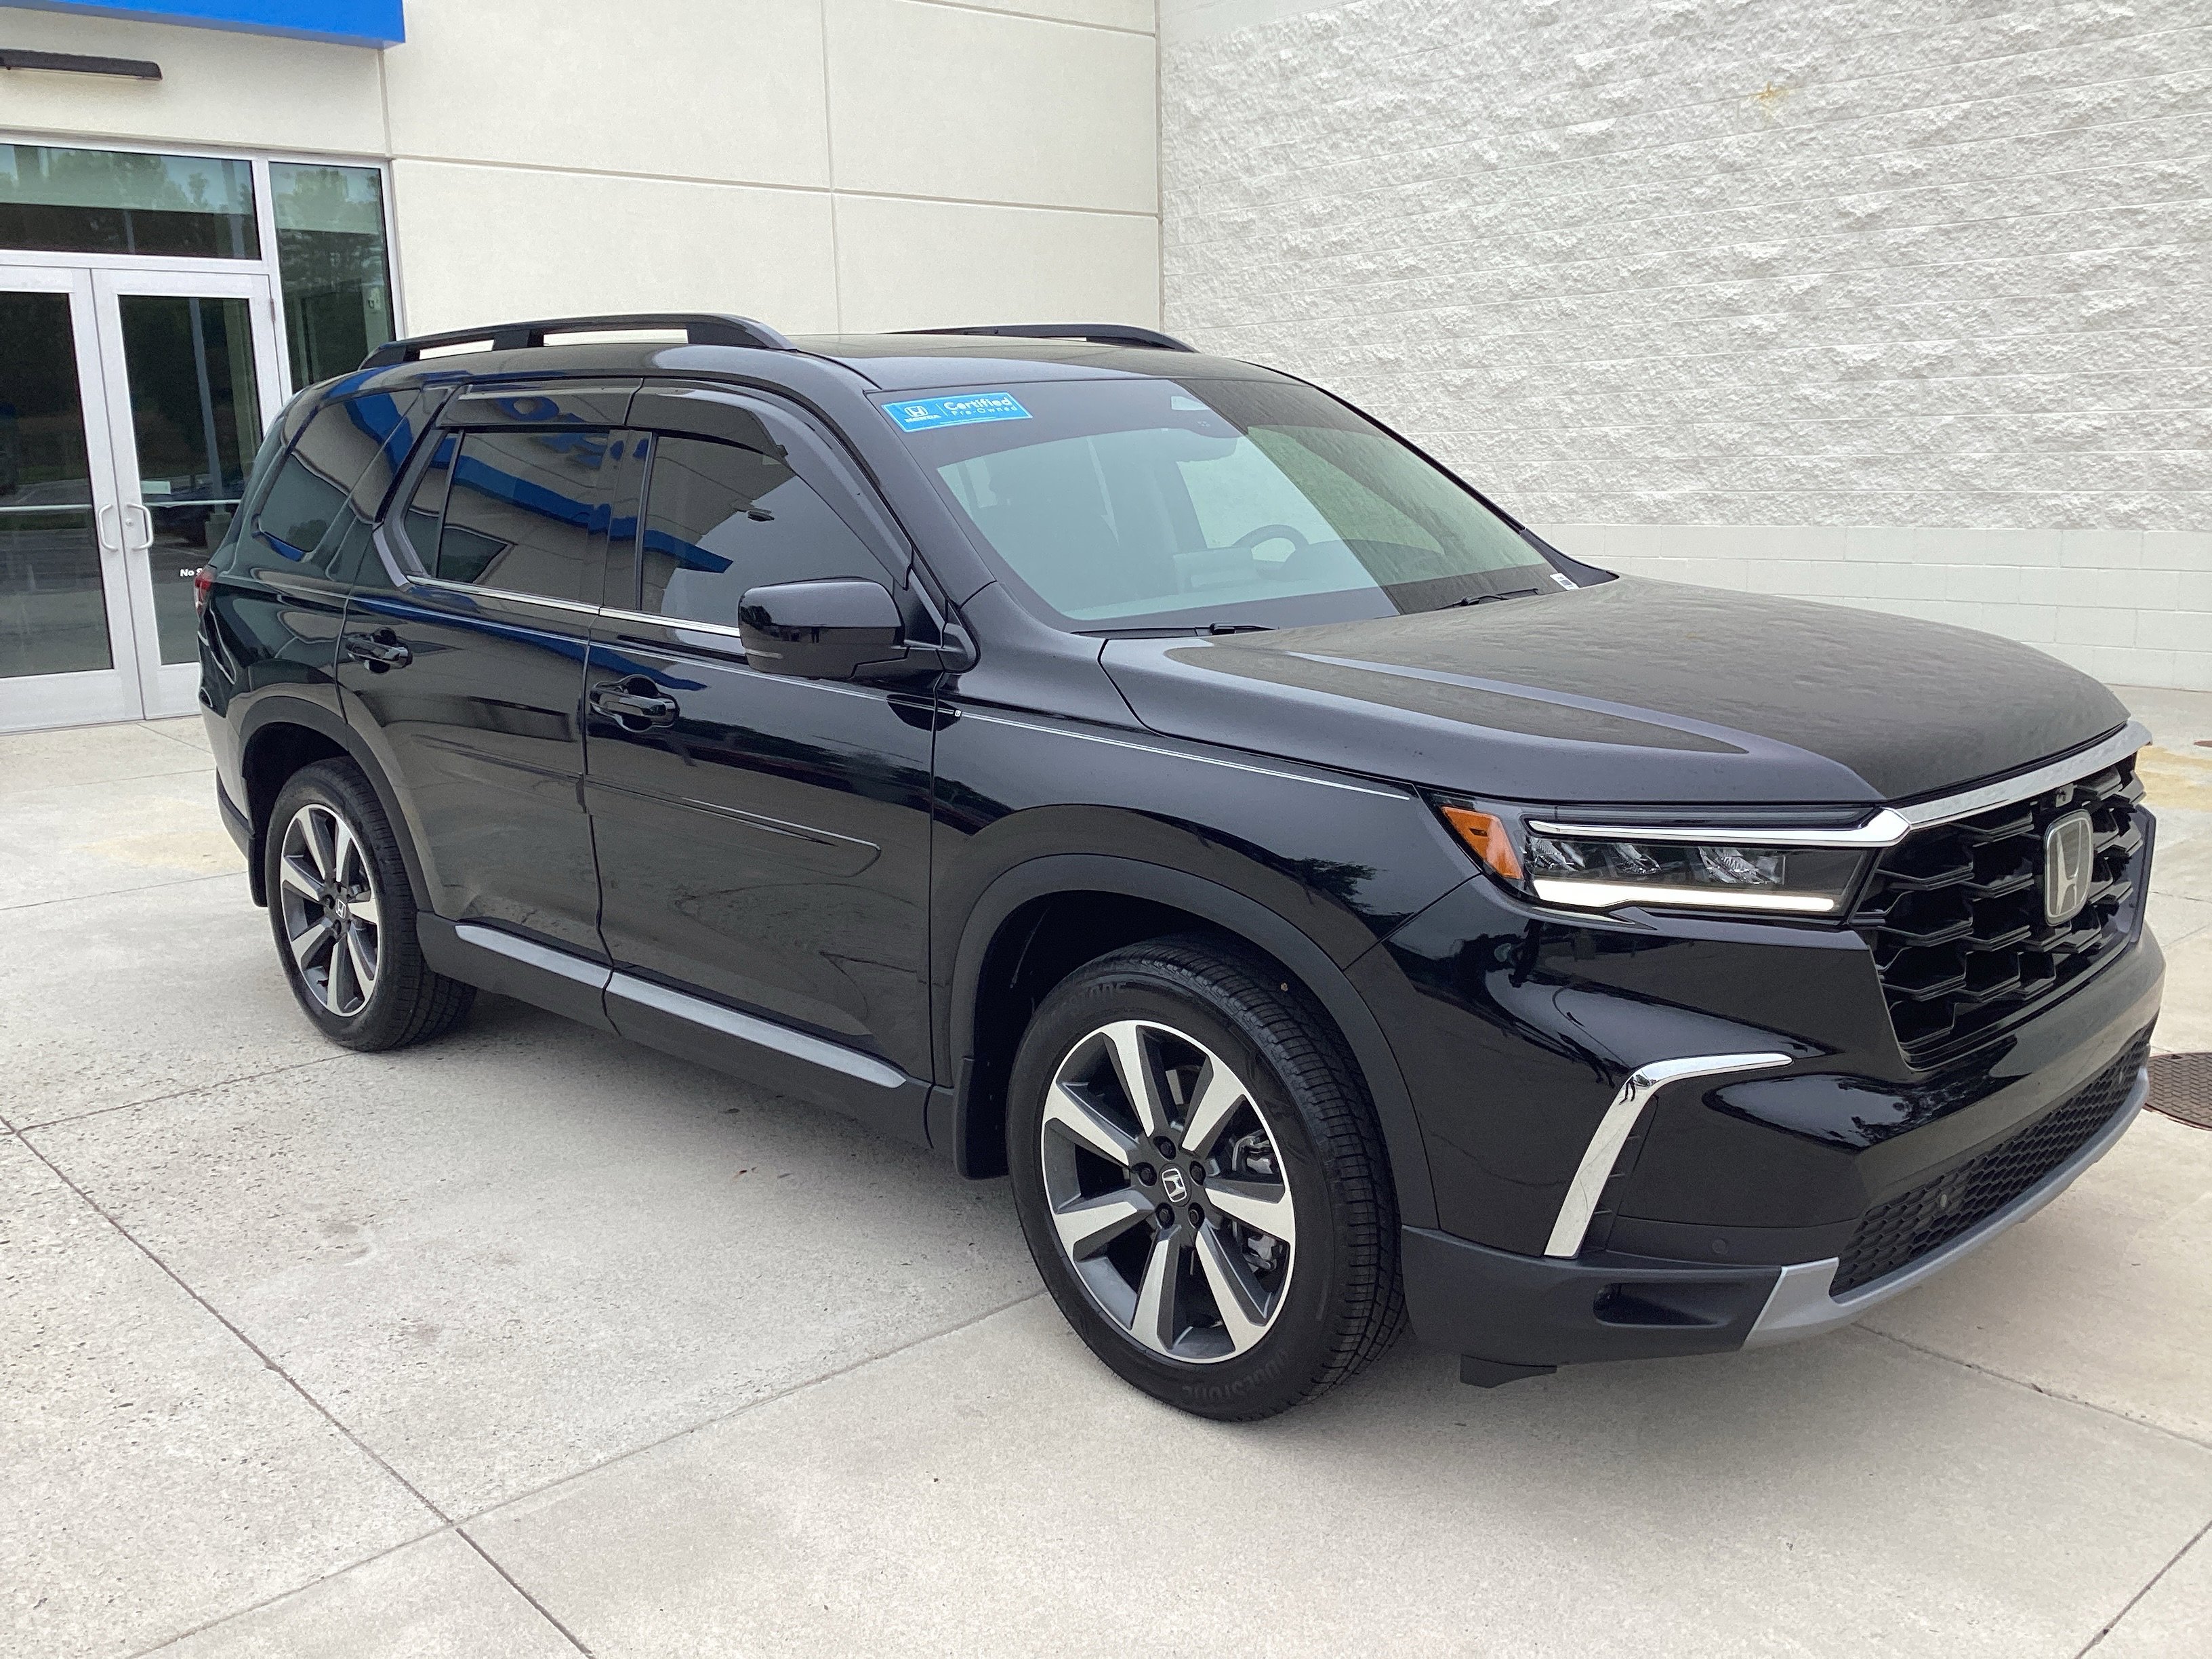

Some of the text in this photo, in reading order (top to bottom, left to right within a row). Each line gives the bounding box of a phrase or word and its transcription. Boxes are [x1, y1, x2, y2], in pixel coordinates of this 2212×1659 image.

[943, 396, 1013, 411] Certified
[951, 406, 1018, 416] Pre-Owned
[904, 414, 941, 423] HONDA
[180, 569, 194, 577] No
